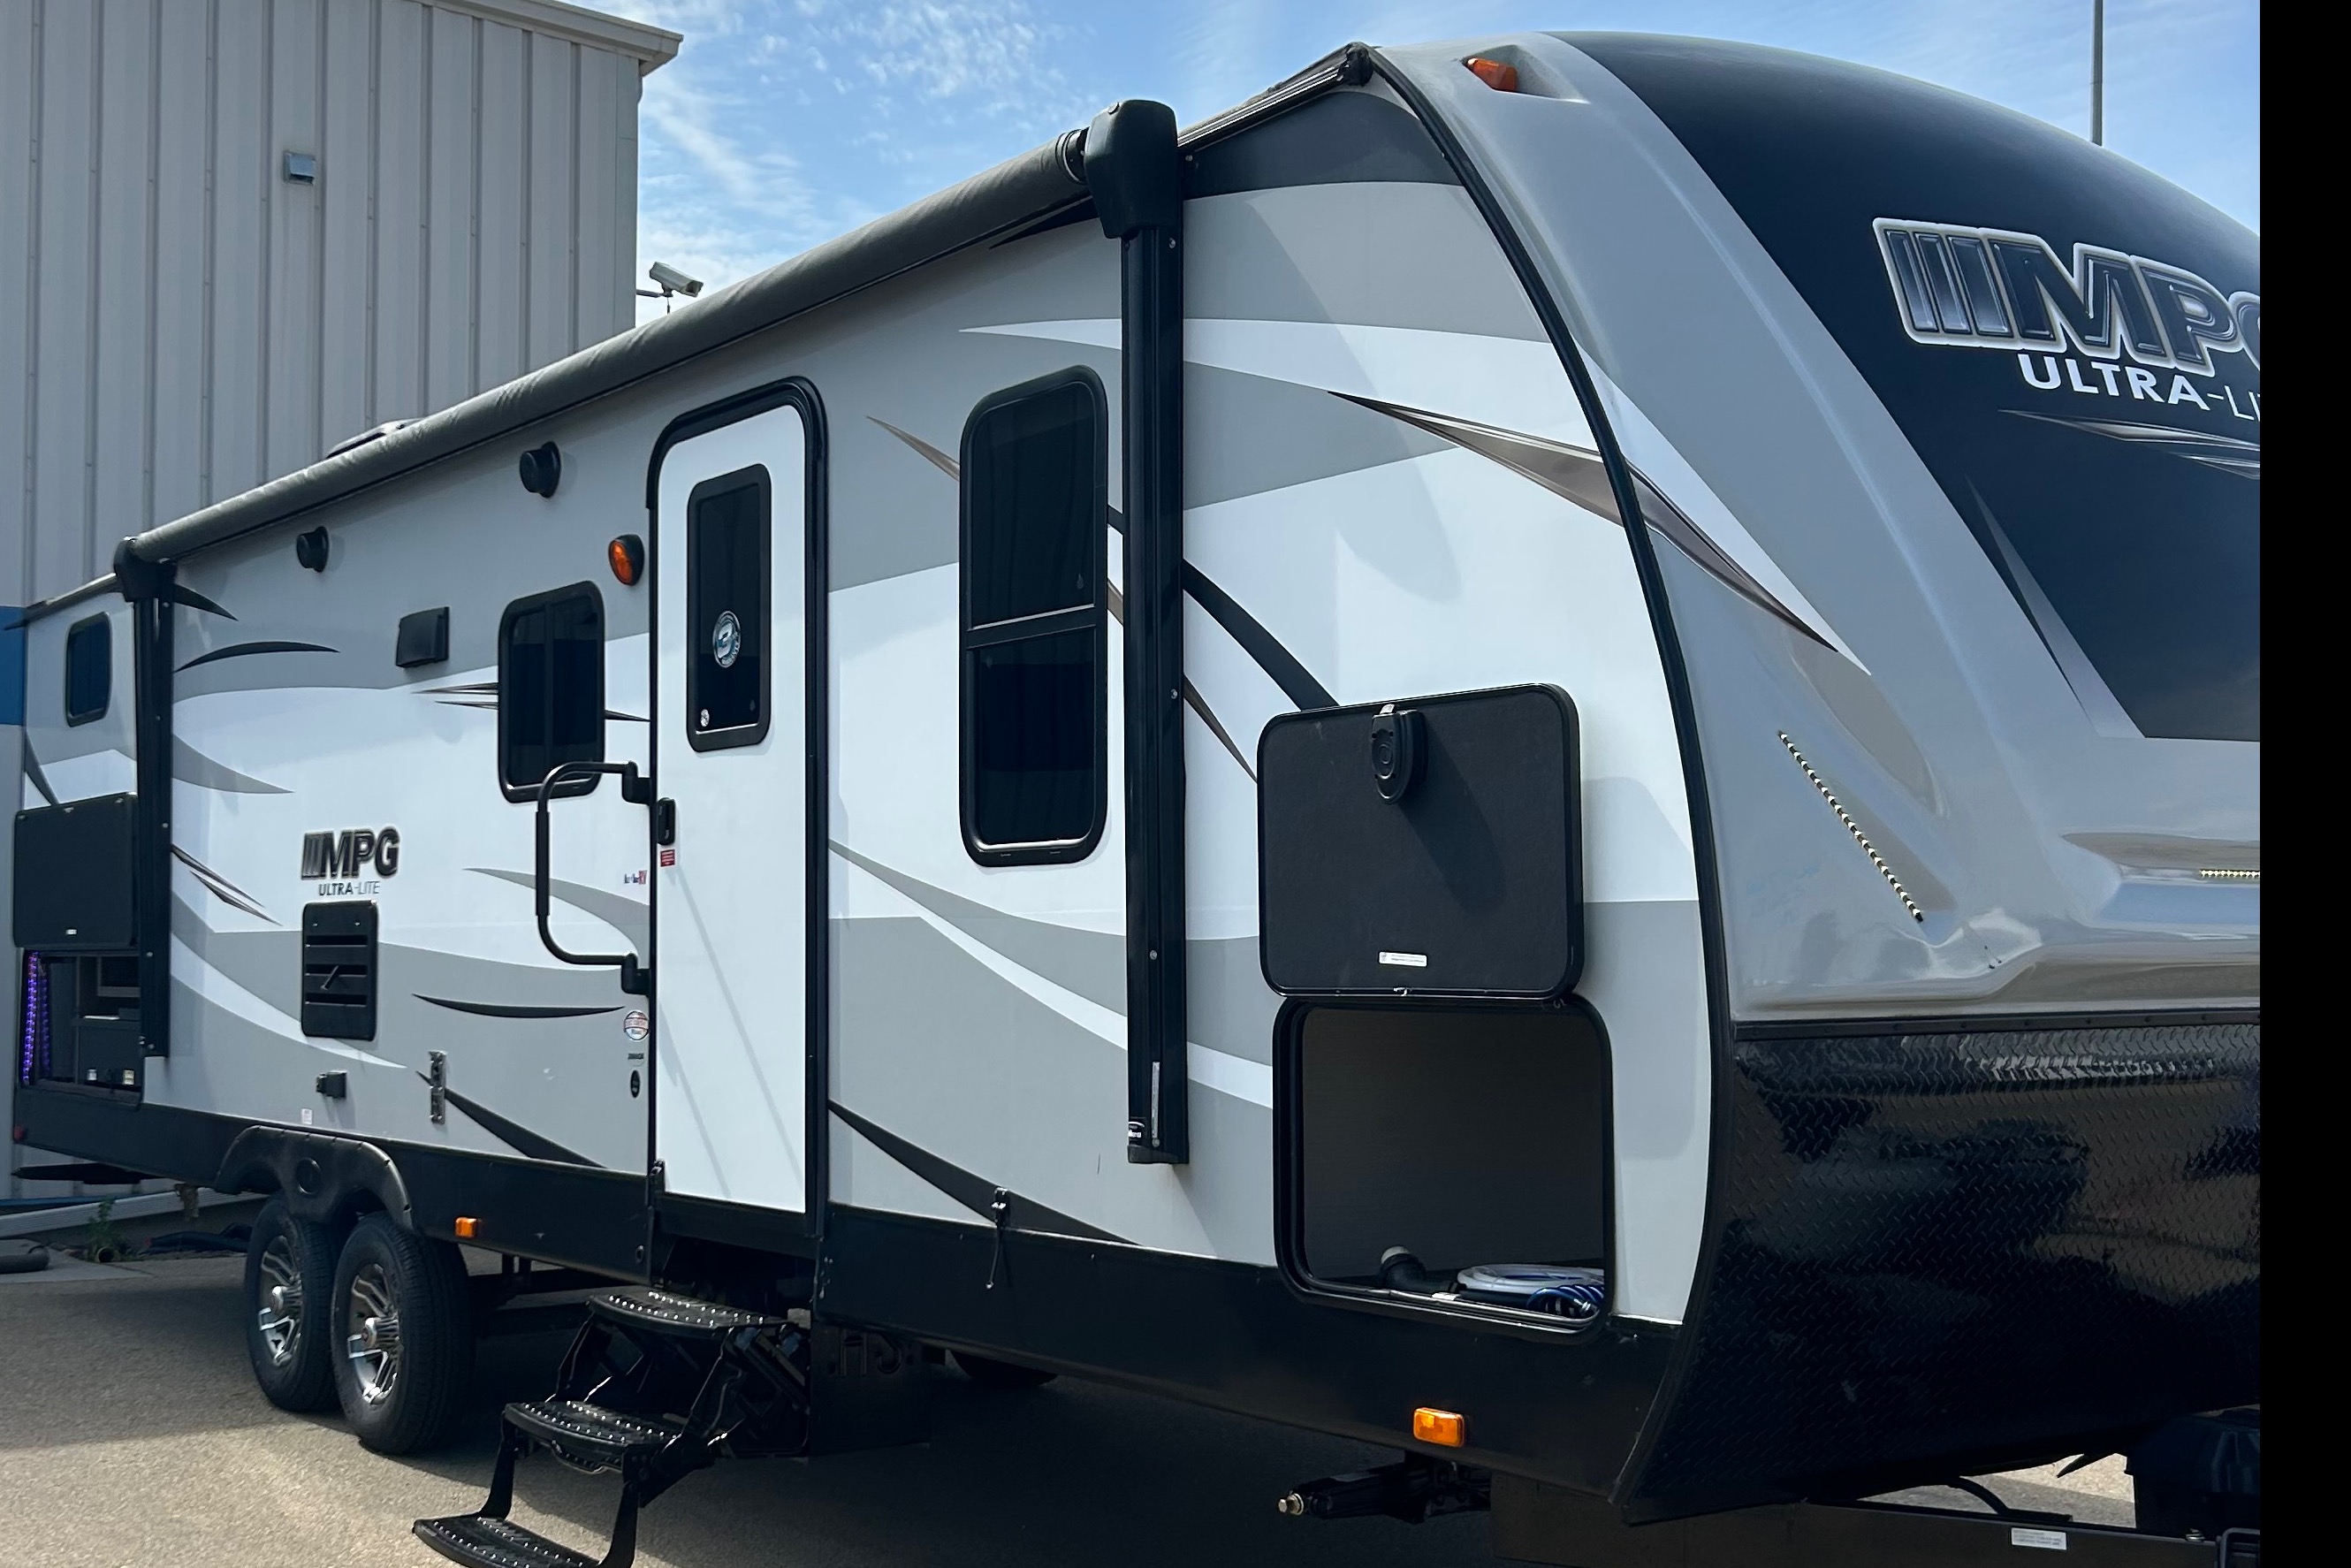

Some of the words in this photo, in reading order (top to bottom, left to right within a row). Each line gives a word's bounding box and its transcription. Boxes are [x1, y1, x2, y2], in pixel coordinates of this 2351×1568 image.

[2018, 354, 2260, 422] ULTRA-LI
[319, 826, 400, 879] MPG
[318, 880, 381, 896] ULTRA-LITE
